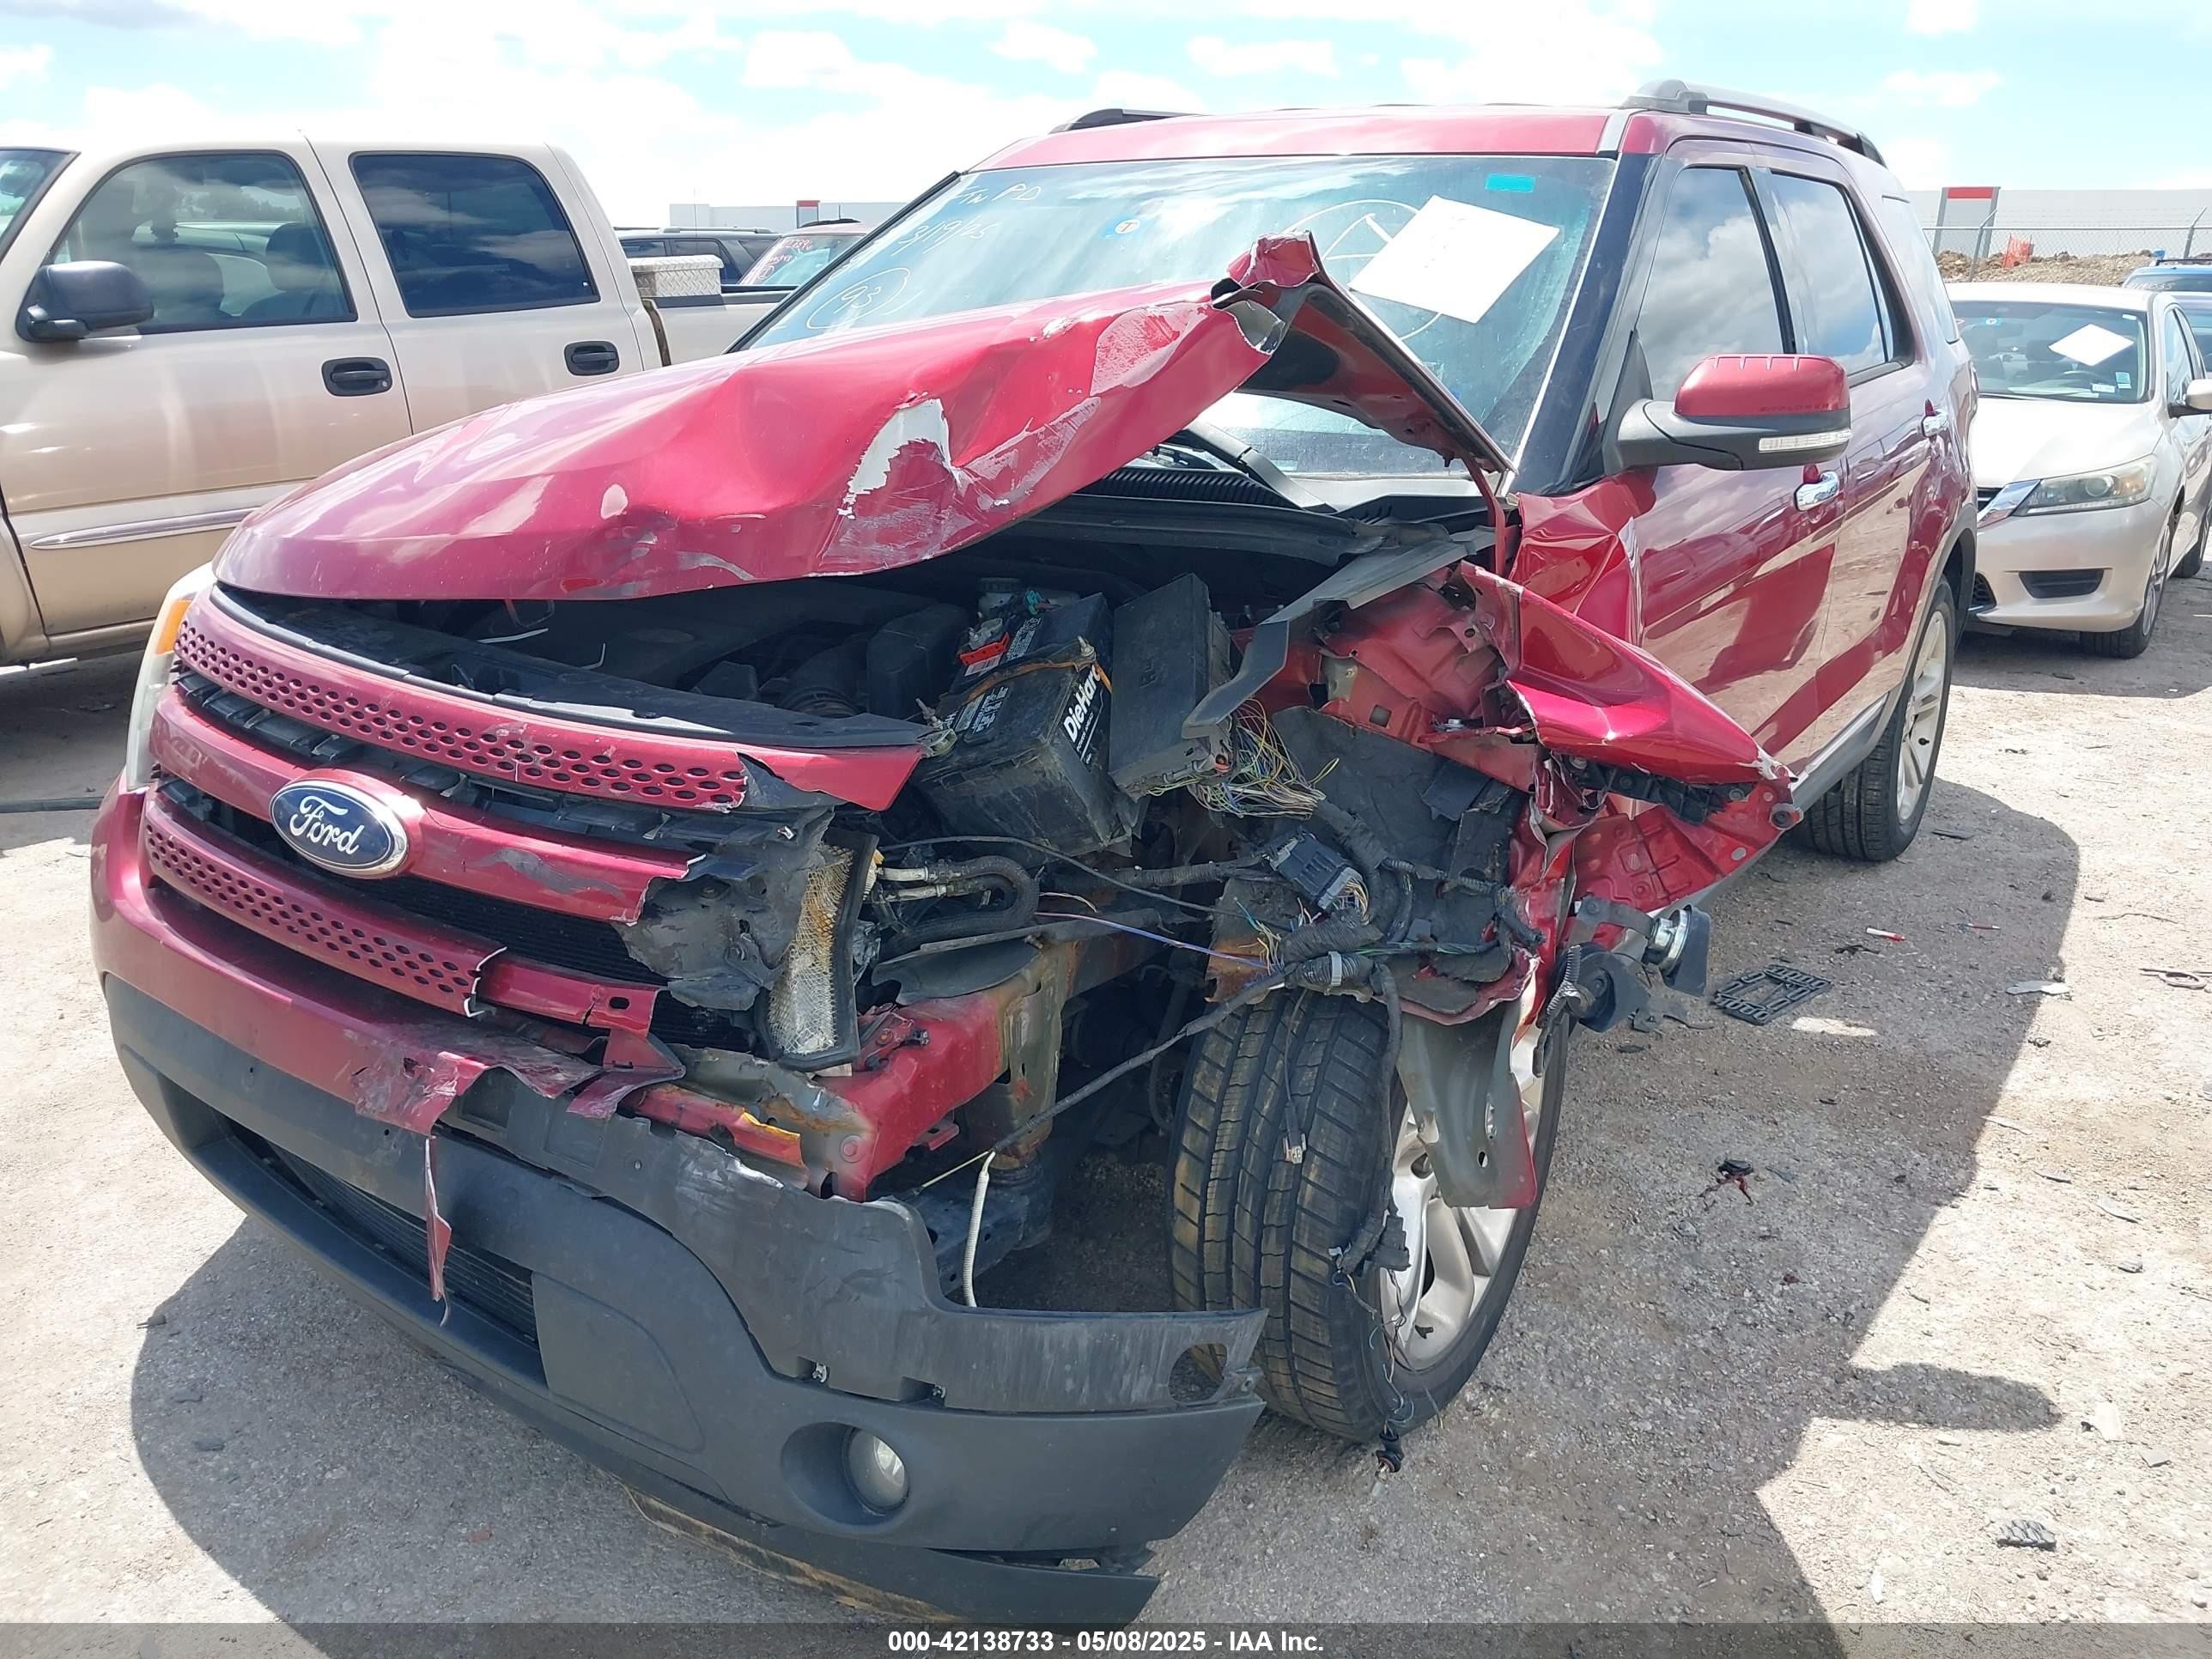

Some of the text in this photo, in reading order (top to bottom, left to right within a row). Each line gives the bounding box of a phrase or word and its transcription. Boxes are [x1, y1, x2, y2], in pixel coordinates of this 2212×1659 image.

[991, 183, 1042, 201] PD
[891, 216, 1003, 256] 3/19/25
[833, 285, 882, 314] 93
[289, 795, 365, 855] Ford
